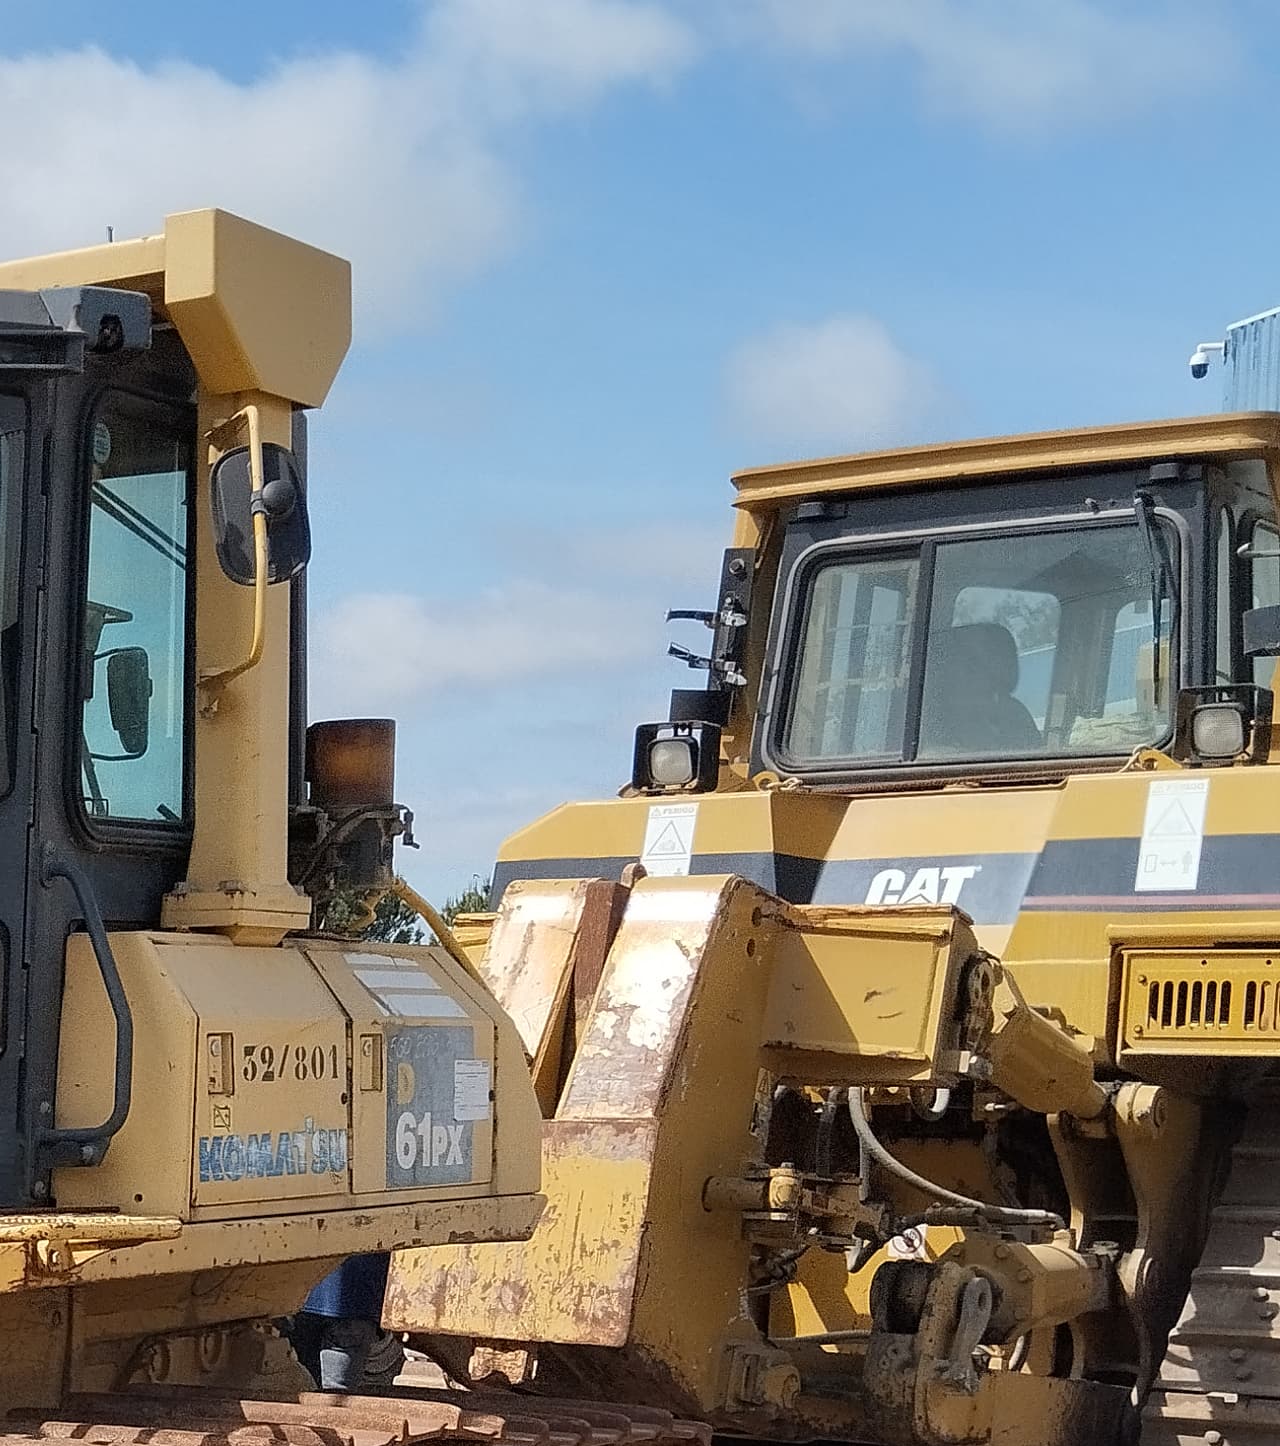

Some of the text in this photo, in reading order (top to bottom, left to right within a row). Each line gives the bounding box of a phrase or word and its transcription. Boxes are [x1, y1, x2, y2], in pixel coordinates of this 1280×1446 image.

[864, 866, 976, 905] CAT
[199, 1115, 347, 1183] KOMATSU
[396, 1112, 465, 1170] 61PX
